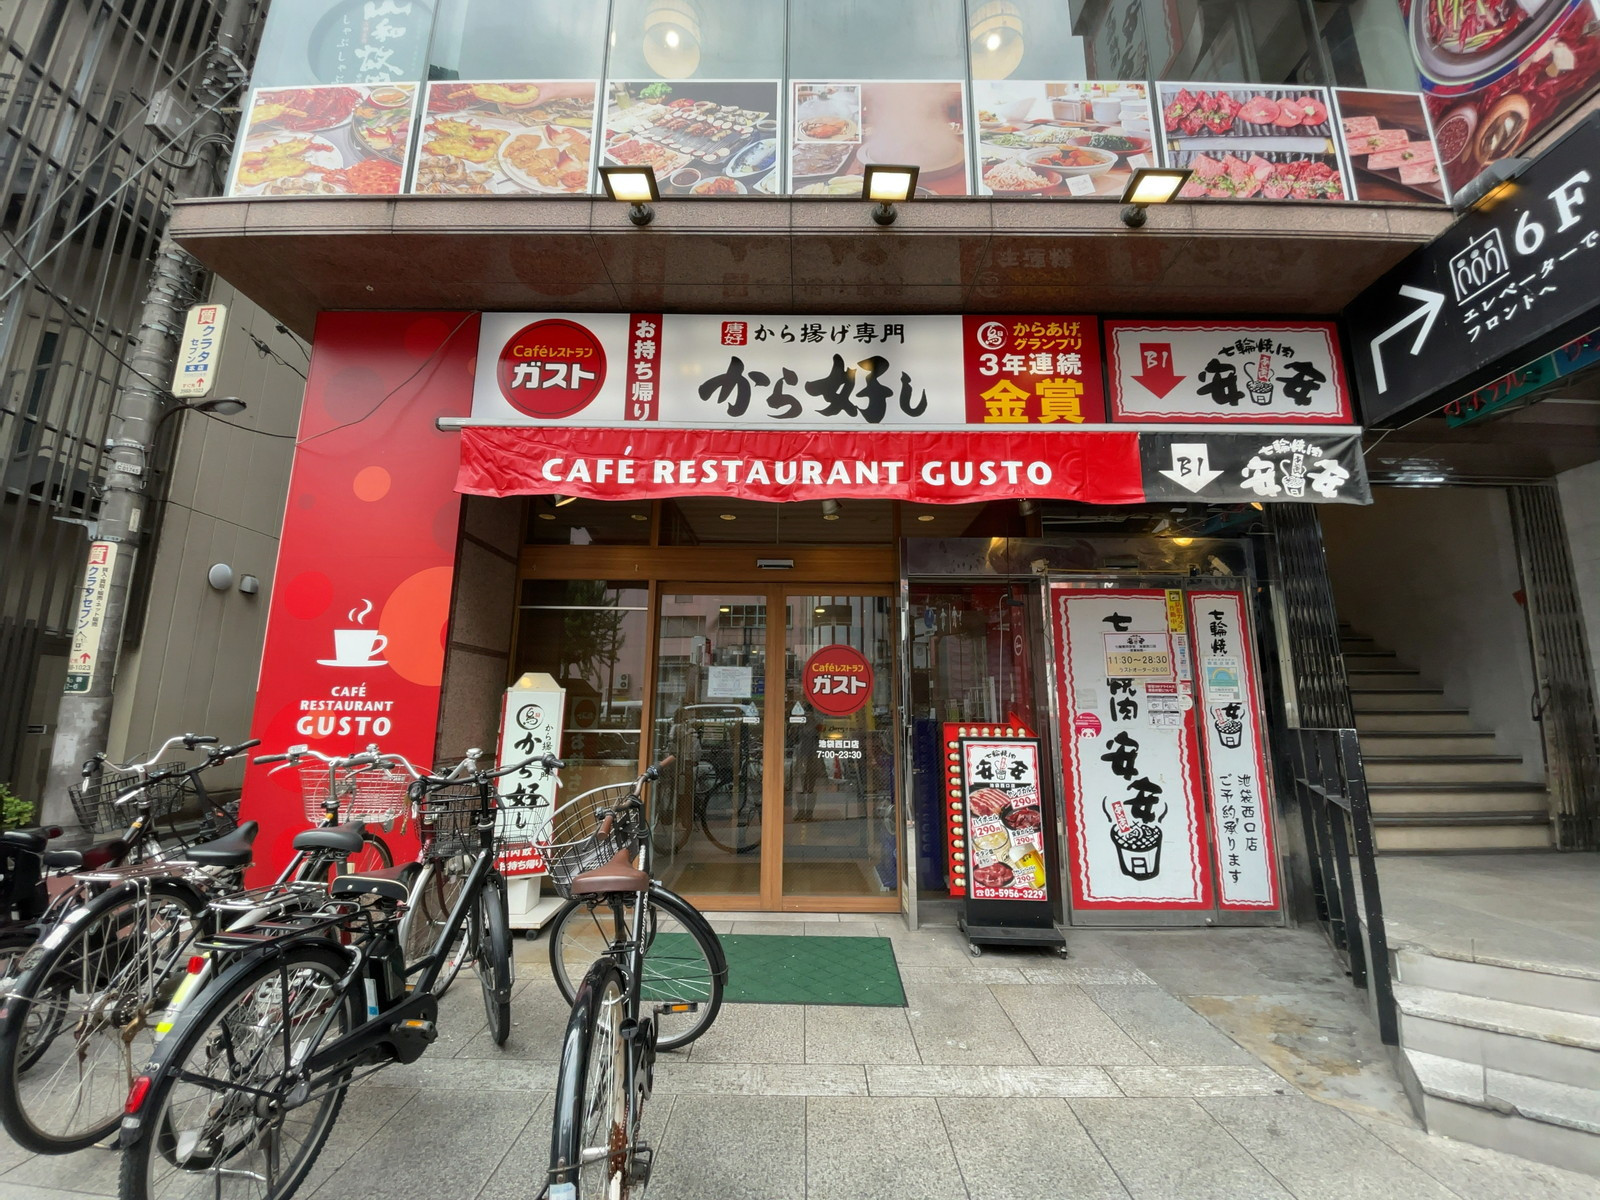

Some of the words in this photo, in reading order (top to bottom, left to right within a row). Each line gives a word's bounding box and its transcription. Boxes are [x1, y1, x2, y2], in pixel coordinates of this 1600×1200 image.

[1514, 170, 1590, 255] 6F
[1463, 230, 1599, 324] エレベーターで
[1013, 321, 1081, 337] からあげ
[1467, 286, 1557, 342] フロントへ
[197, 325, 215, 363] クラタ
[754, 322, 905, 345] から揚げ専門
[1014, 338, 1082, 350] グランプリ
[1218, 337, 1295, 359] 七輪焼肉
[186, 338, 199, 364] セブン
[979, 352, 1083, 376] 3年連続
[511, 361, 595, 390] ガスト
[632, 319, 656, 421] お持ち帰り
[698, 353, 928, 423] から好し
[980, 378, 1086, 423] 金賞
[1258, 438, 1323, 458] 七輪焼肉
[541, 446, 635, 484] CAFÉ
[653, 459, 904, 485] RESTAURANT
[921, 460, 1052, 486] GUSTO
[78, 566, 99, 630] クラタセブン
[1208, 609, 1228, 656] 七輪焼
[1101, 611, 1139, 722] 七焼肉
[331, 682, 367, 697] CAFÉ
[812, 675, 867, 695] ガスト
[300, 700, 394, 711] RESTAURANT
[296, 716, 391, 736] GUSTO
[1219, 773, 1242, 884] ご予約承ります
[1237, 773, 1258, 851] 池袋西口店
[985, 888, 1043, 899] 03-5956-3229
